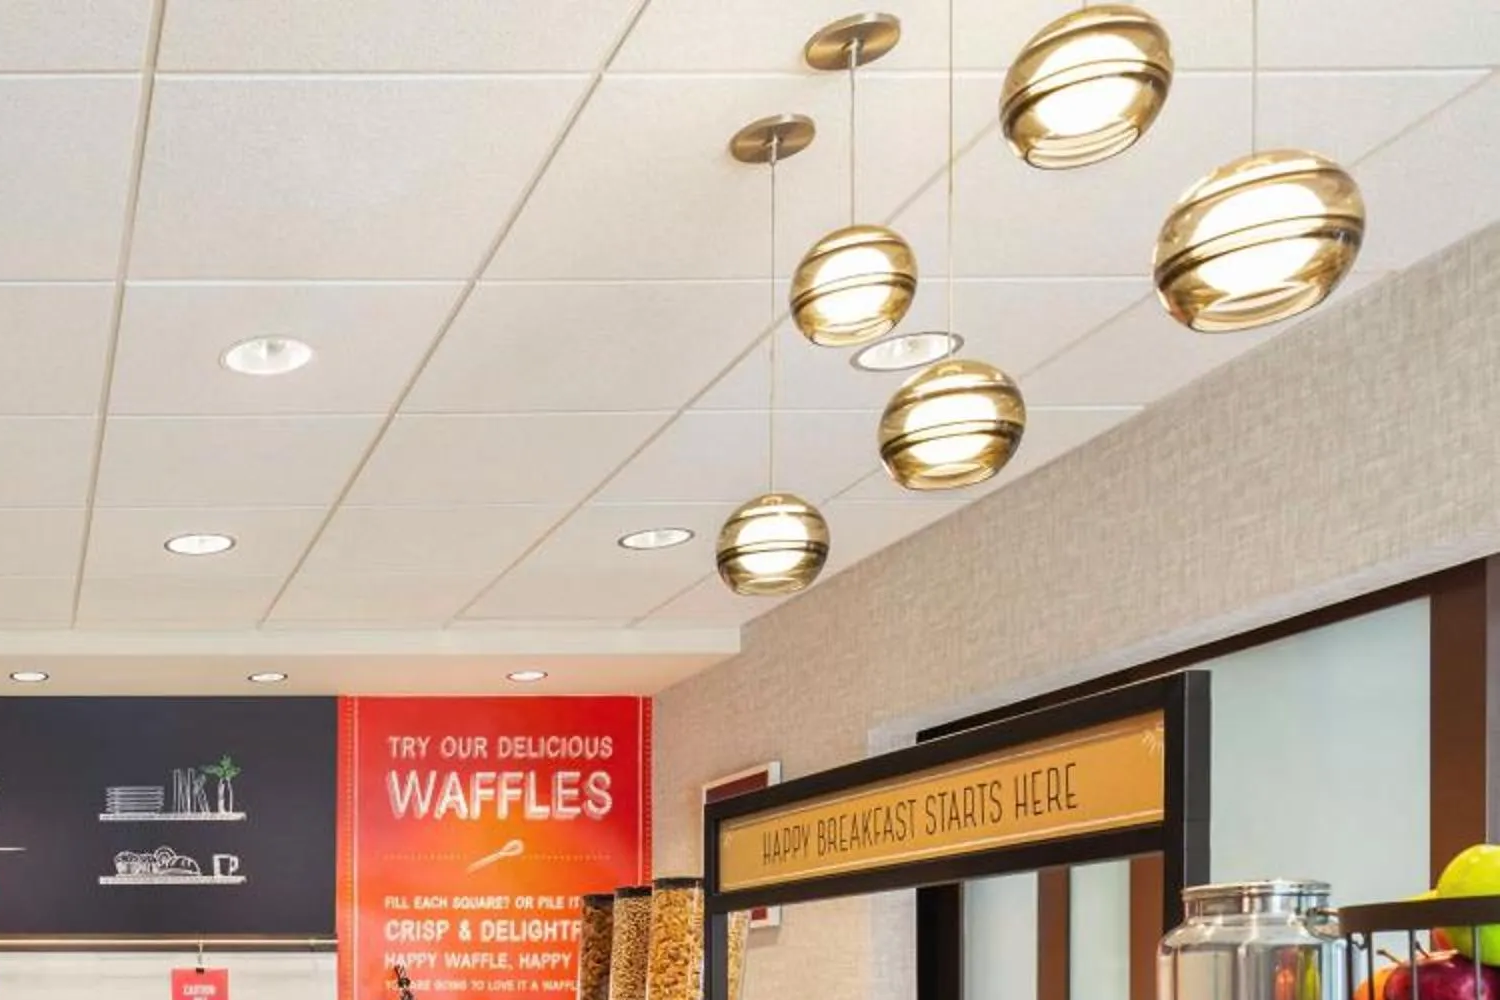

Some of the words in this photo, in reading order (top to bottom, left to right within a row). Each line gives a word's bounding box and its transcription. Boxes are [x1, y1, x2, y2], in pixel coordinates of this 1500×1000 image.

[389, 736, 431, 758] TRY
[441, 736, 488, 758] OUR
[498, 736, 613, 758] DELICIOUS
[386, 769, 613, 820] WAFFLES
[762, 824, 810, 865] HAPPY
[816, 799, 917, 857] BREAKFAST
[925, 780, 1003, 836] STARTS
[1013, 762, 1077, 820] HERE
[385, 896, 409, 909] FILL
[414, 896, 448, 909] EACH
[515, 895, 534, 909] OR
[538, 895, 565, 909] PILE
[385, 919, 449, 941] CRISP
[459, 919, 472, 941] &
[481, 919, 582, 942] DELIGHTF
[385, 952, 437, 970] HAPPY
[444, 951, 514, 971] WAFFLE,
[519, 952, 571, 970] HAPPY
[488, 980, 515, 992] LOVE
[543, 980, 578, 993] WAFFL
